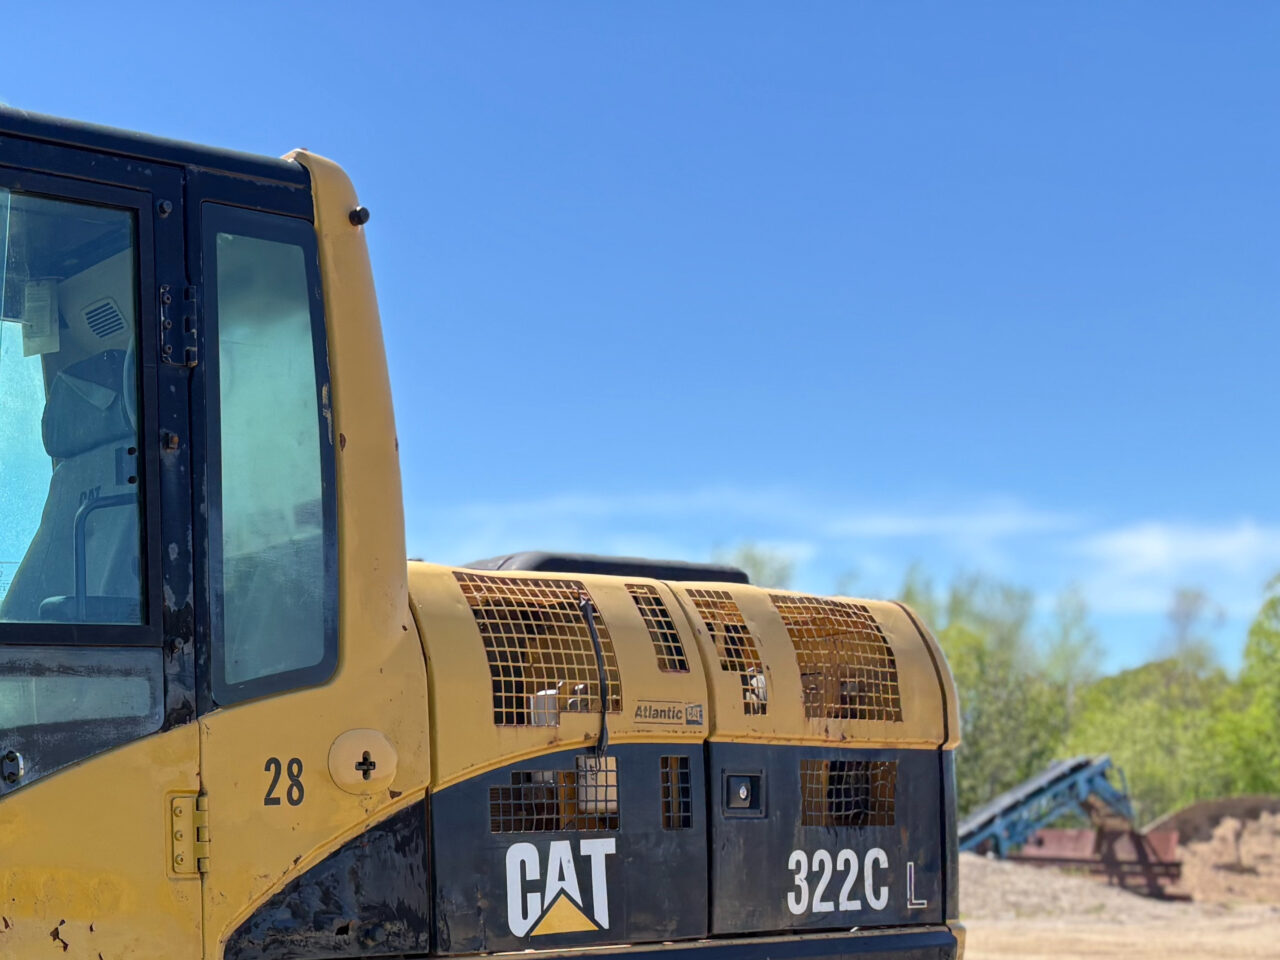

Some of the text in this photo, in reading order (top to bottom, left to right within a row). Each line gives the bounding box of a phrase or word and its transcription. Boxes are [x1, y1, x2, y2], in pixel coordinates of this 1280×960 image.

[635, 704, 683, 720] Atlantic
[264, 757, 304, 806] 28
[505, 838, 616, 937] CAT
[787, 847, 928, 915] 322C L
